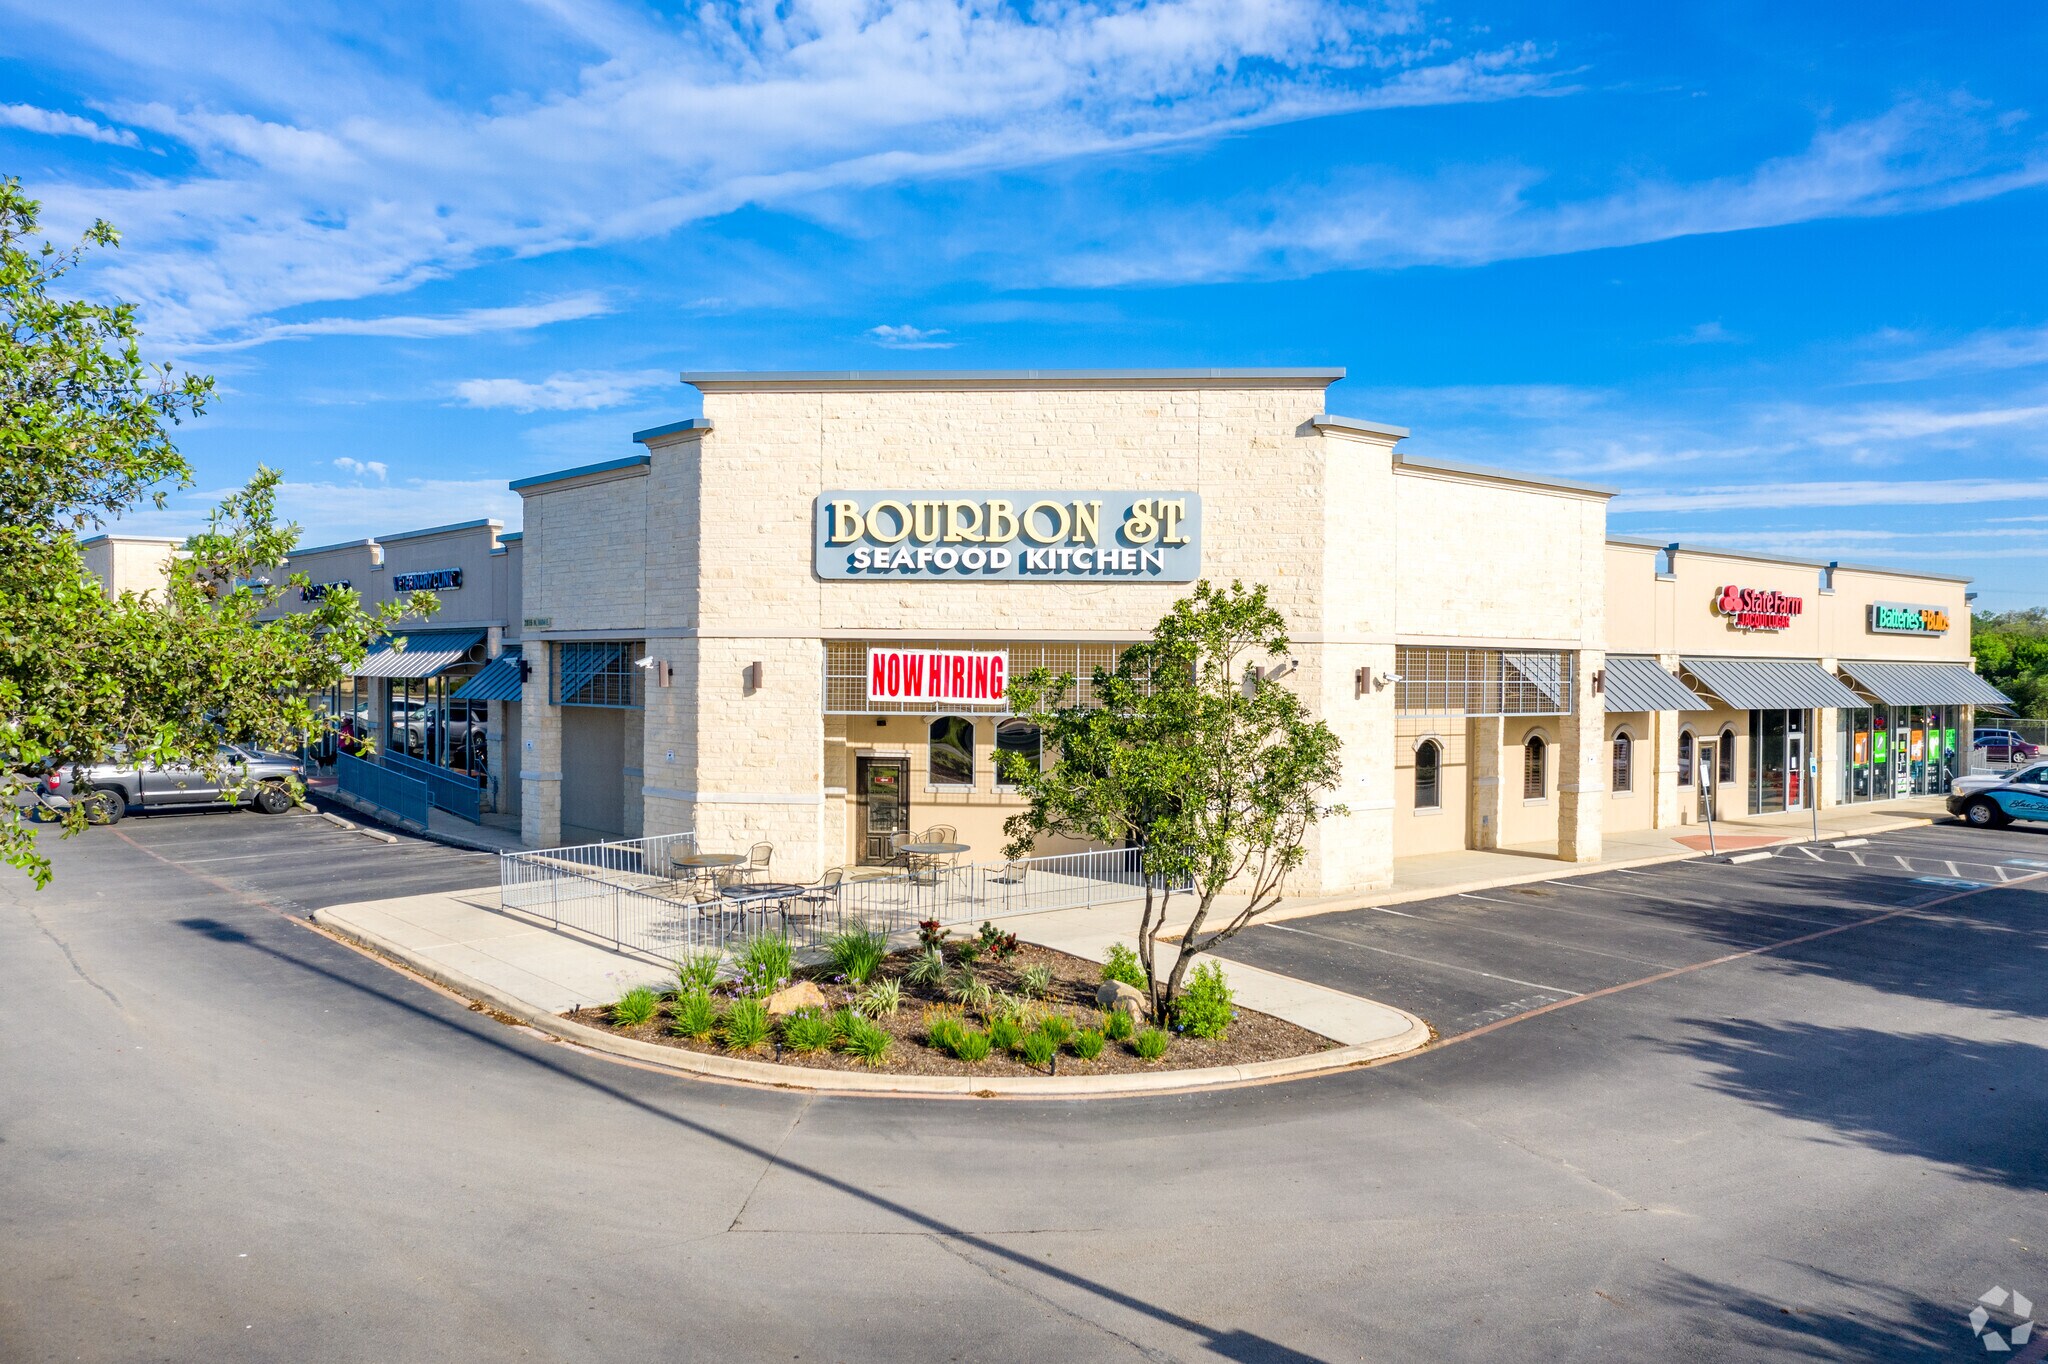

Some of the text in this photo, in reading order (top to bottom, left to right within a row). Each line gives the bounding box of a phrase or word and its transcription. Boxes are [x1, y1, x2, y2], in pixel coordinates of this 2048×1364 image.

[830, 497, 1191, 545] BOURBON ST.
[852, 546, 1165, 570] SEAFOOD KITCHEN
[872, 653, 1004, 700] NOW HIRING
